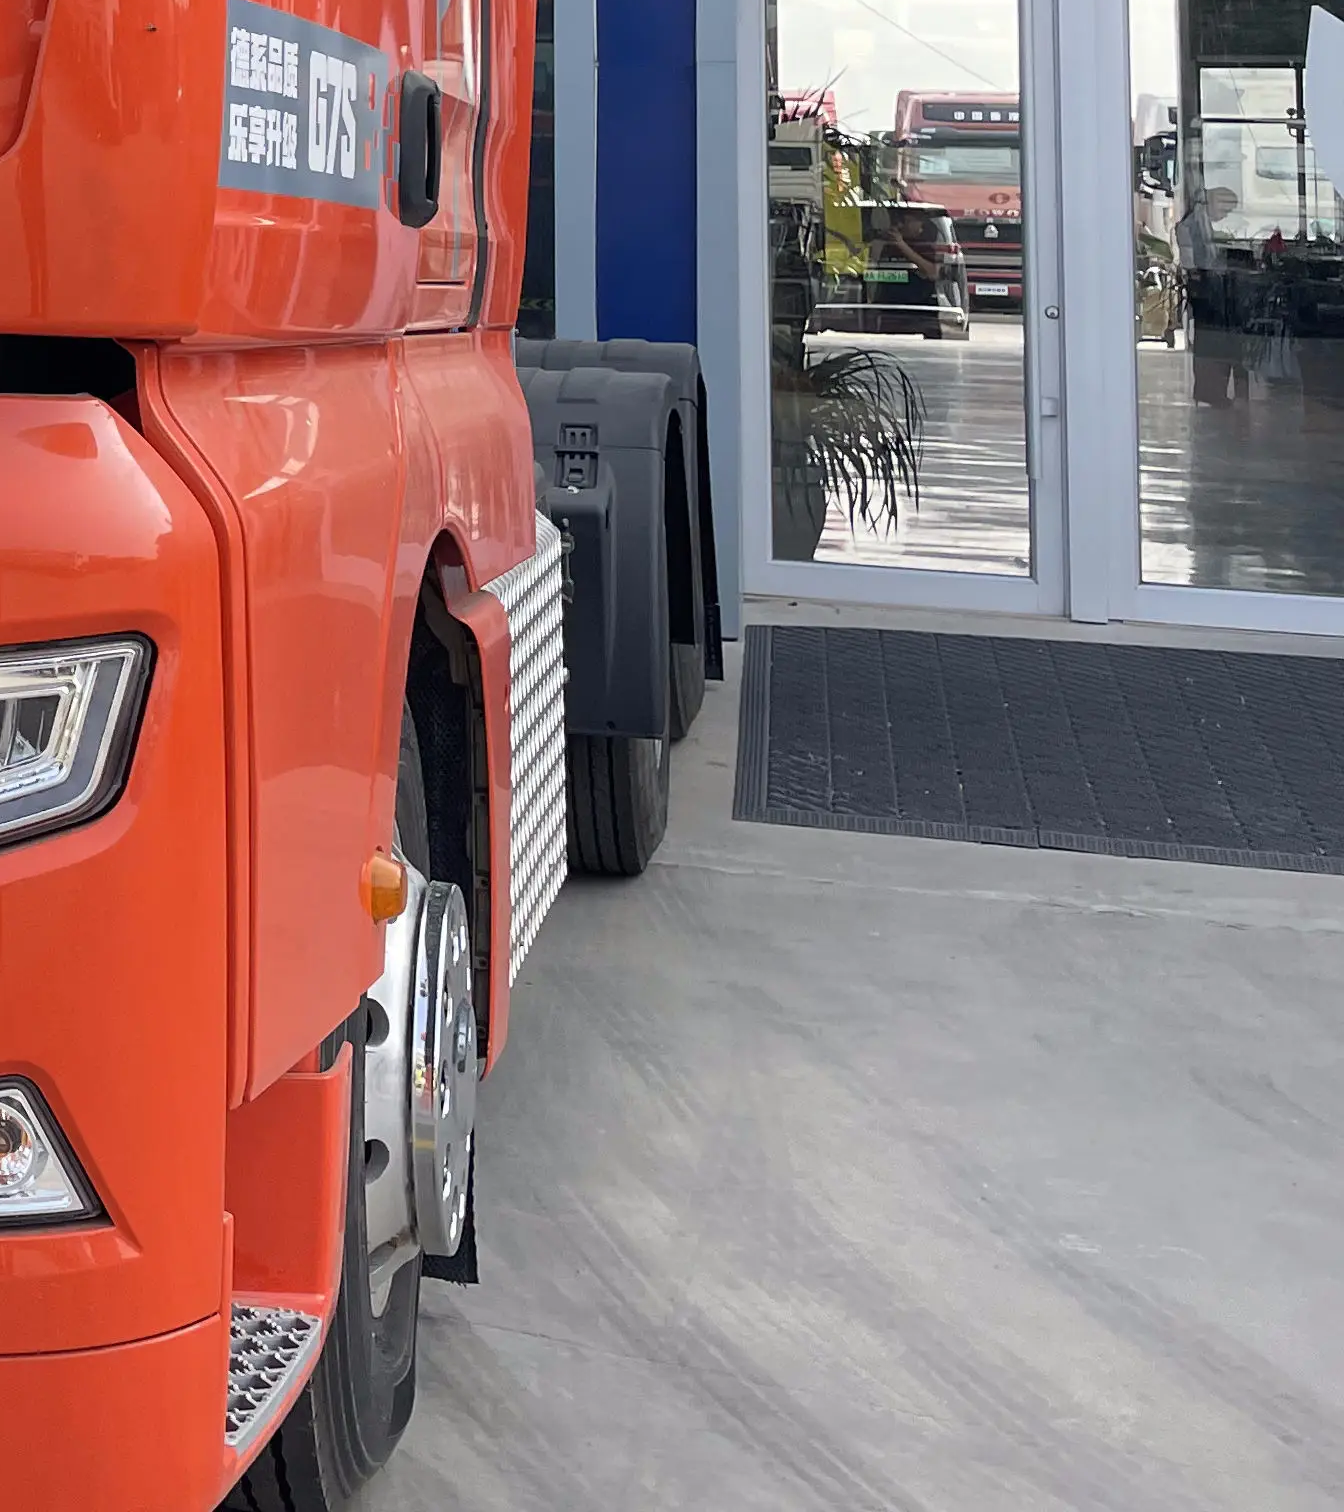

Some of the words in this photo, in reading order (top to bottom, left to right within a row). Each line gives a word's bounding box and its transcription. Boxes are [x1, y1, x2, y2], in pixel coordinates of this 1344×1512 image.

[230, 26, 299, 100] 德系品质
[227, 102, 298, 170] 乐享升级
[308, 50, 357, 180] G7S
